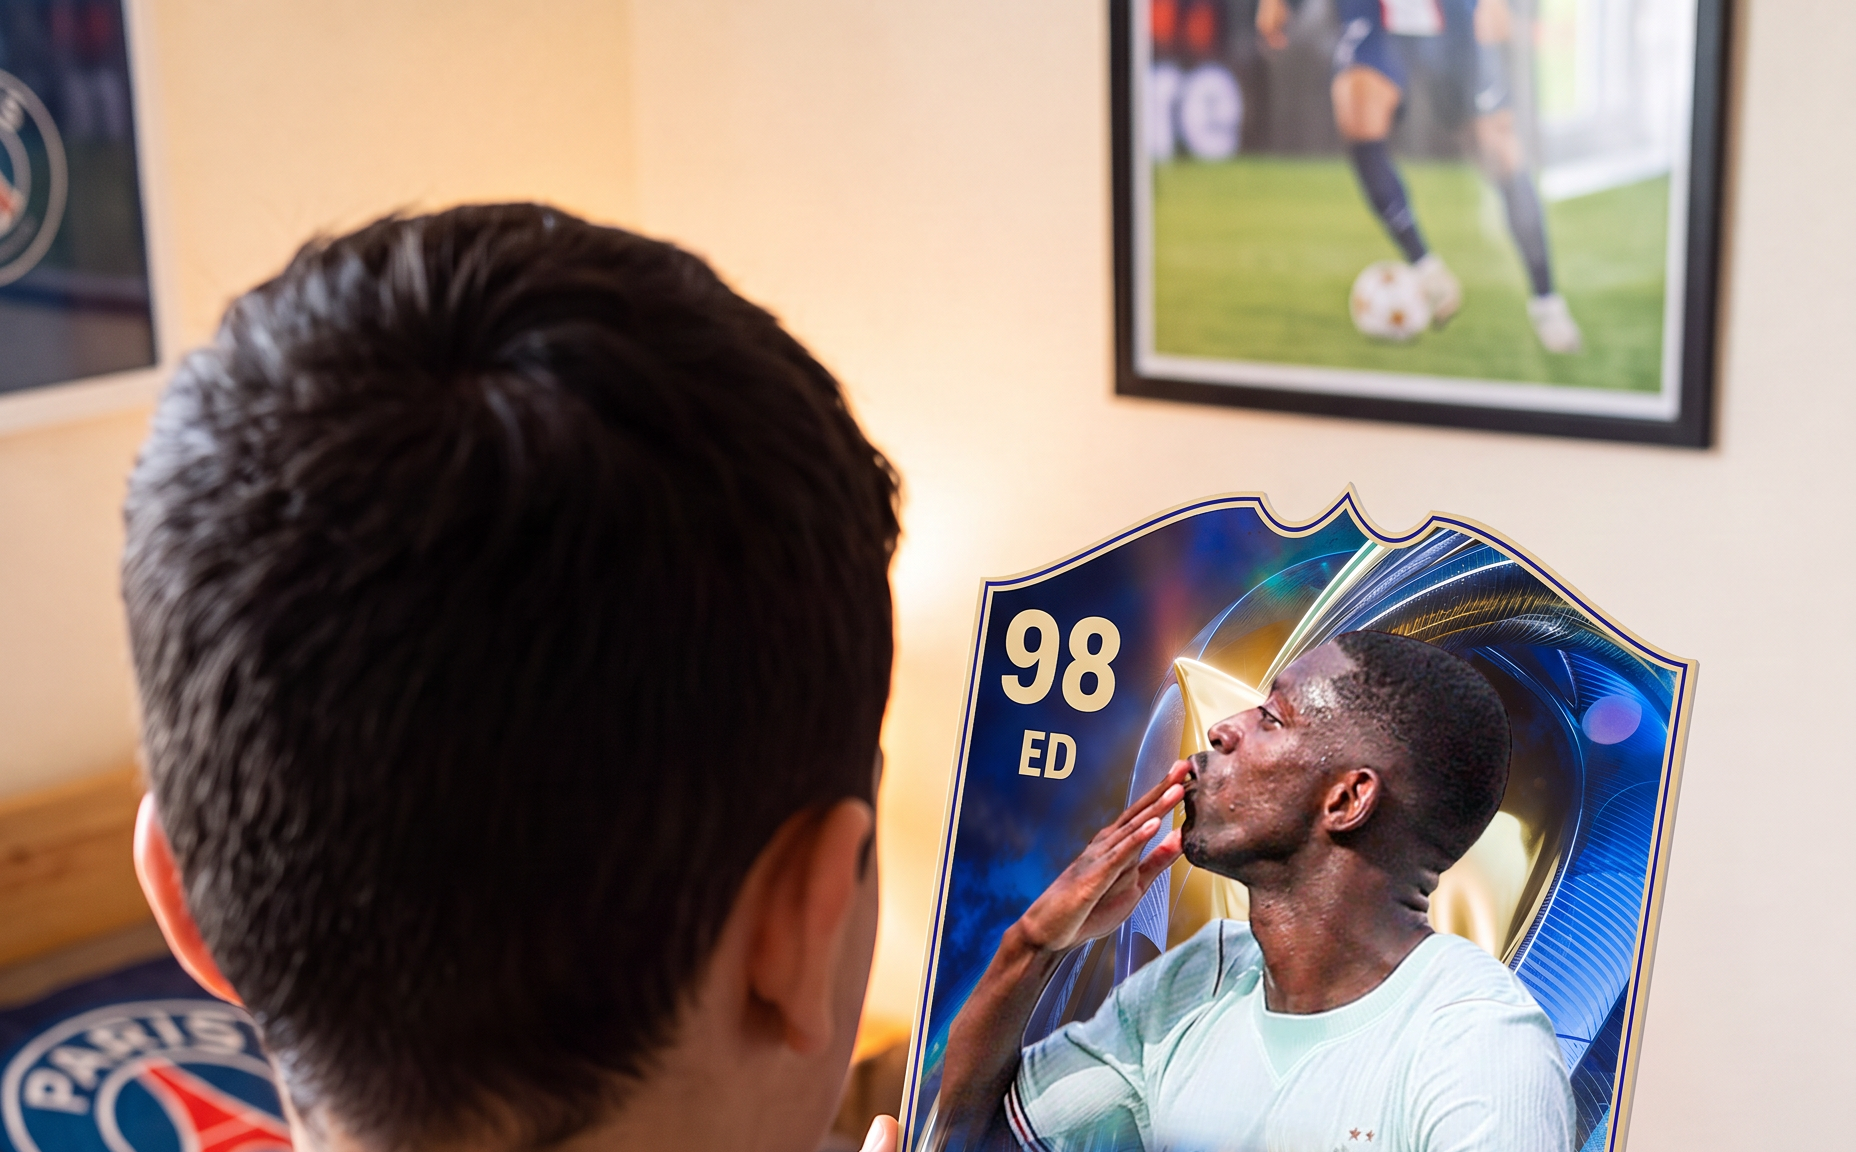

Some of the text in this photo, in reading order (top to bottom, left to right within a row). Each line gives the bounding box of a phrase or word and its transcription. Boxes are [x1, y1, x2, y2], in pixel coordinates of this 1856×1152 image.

[1002, 609, 1121, 713] 98
[1018, 729, 1077, 780] ED
[23, 1010, 245, 1116] PARIS
